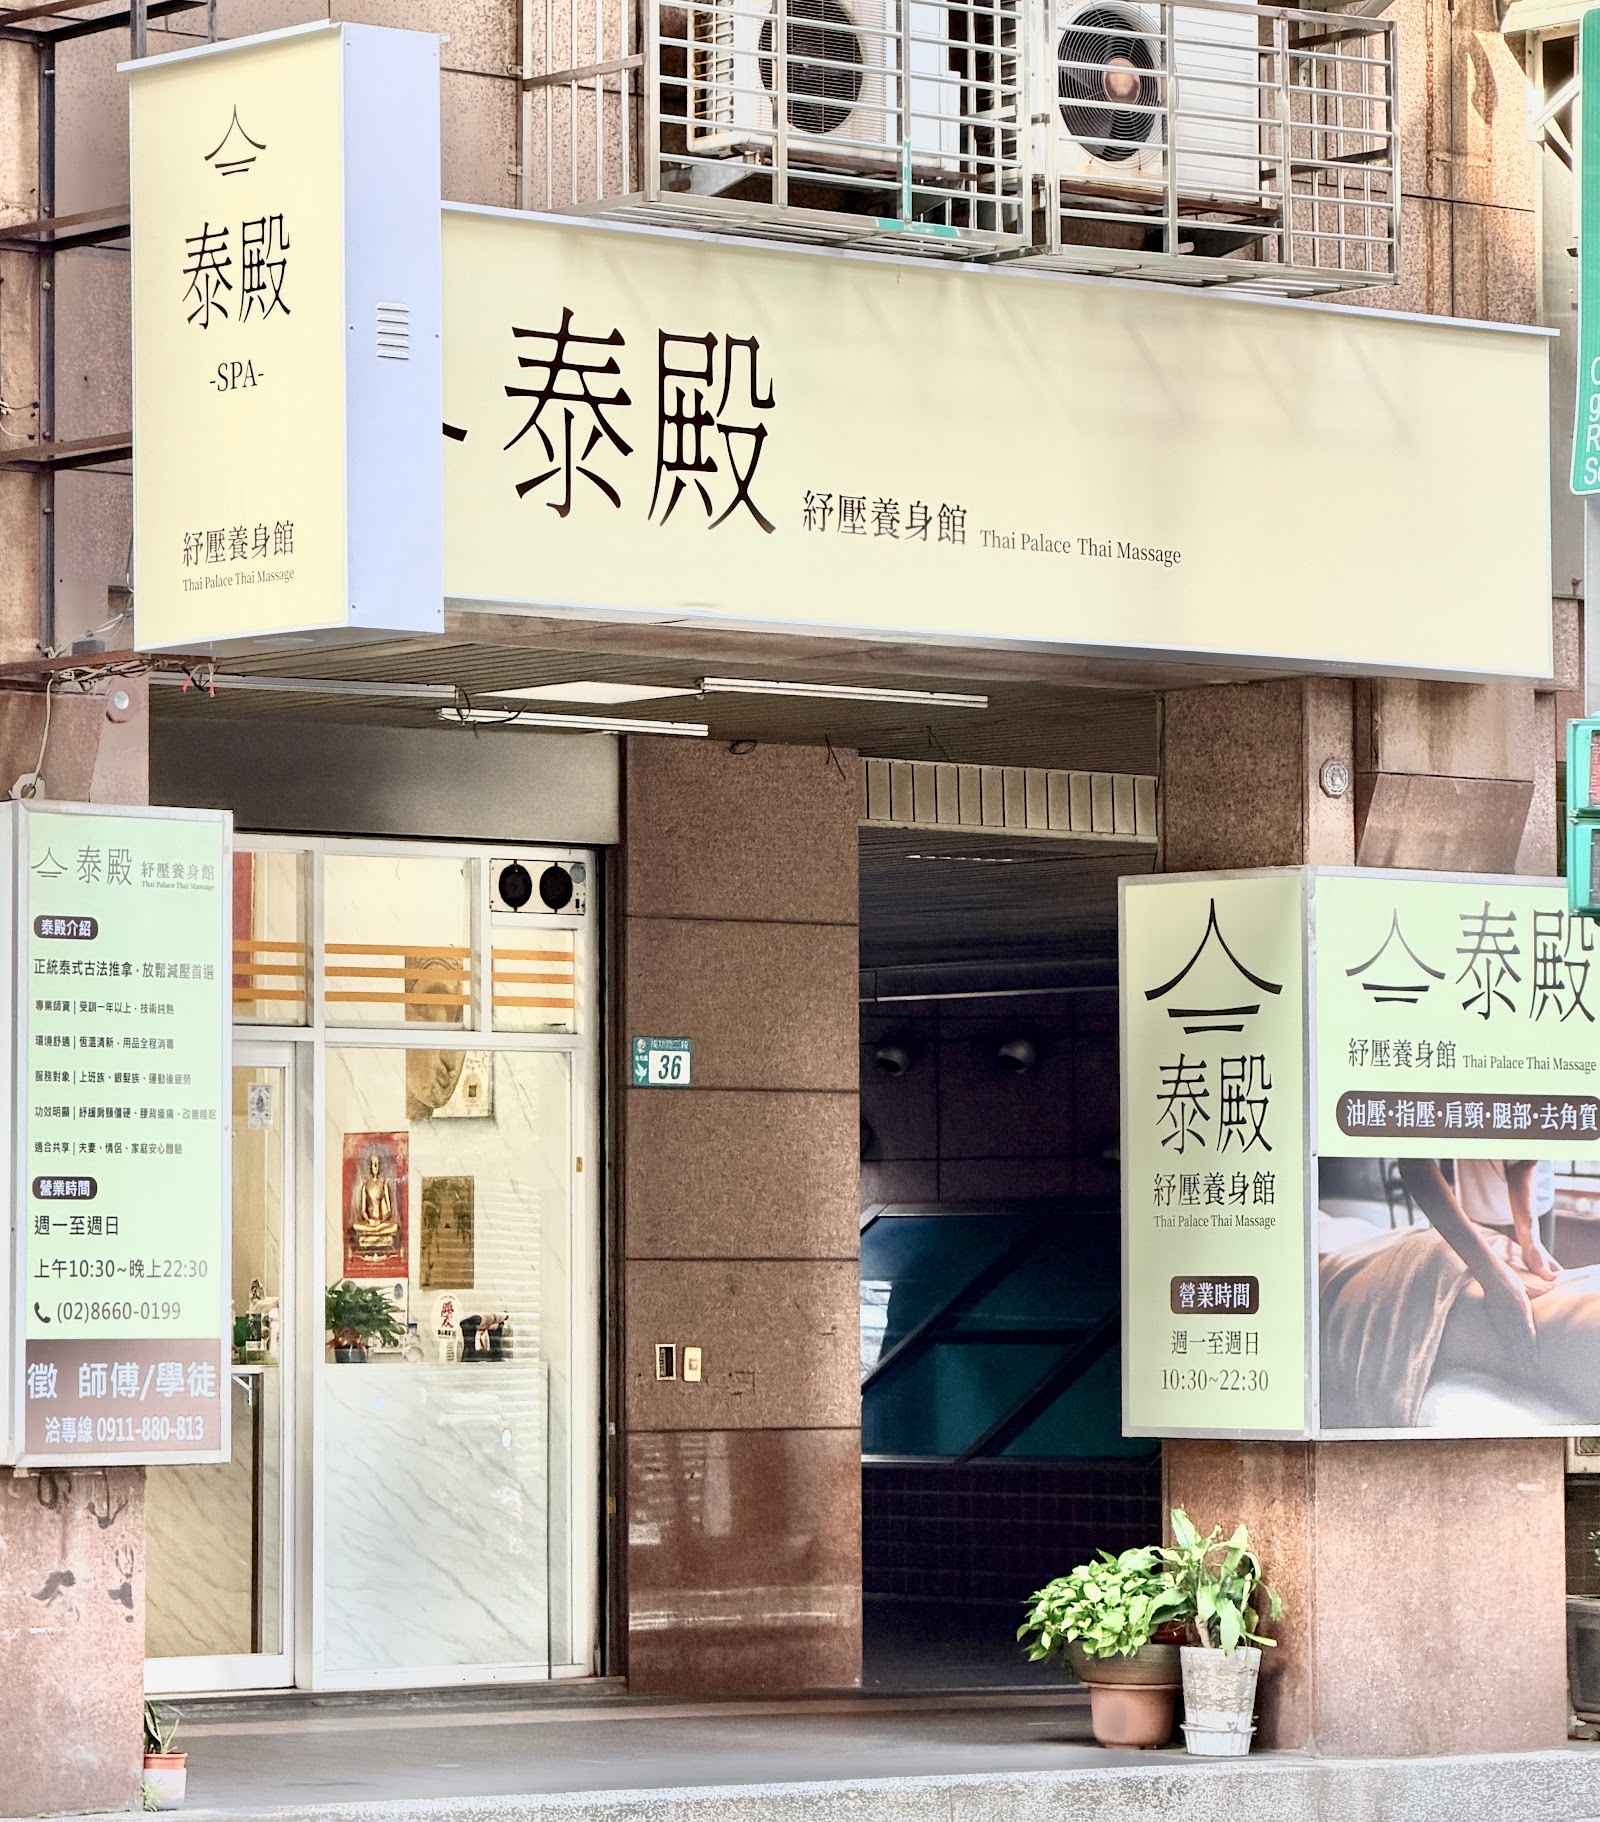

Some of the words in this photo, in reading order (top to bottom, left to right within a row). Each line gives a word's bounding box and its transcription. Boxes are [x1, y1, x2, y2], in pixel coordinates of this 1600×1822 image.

[183, 213, 291, 330] 泰殿
[503, 306, 776, 534] 泰殿
[802, 489, 967, 546] 紓壓養身館
[183, 520, 294, 566] 紓壓養身館
[980, 530, 1016, 550] Thai
[1021, 533, 1071, 554] Palace
[1077, 538, 1112, 558] Thai
[1116, 542, 1182, 568] Massage
[183, 577, 202, 591] Thai
[205, 575, 233, 589] Palace
[235, 571, 255, 585] Thai
[258, 570, 294, 583] Massage
[76, 845, 132, 885] 泰殿
[141, 862, 215, 880] 紓壓養身館
[191, 884, 215, 892] Massage
[41, 919, 91, 937] 泰殿介紹
[1456, 900, 1596, 1022] 泰殿
[1349, 1038, 1456, 1069] 紓壓養身館
[1463, 1055, 1487, 1068] Thai
[1490, 1056, 1524, 1069] Palace
[1526, 1057, 1550, 1069] Thai
[1553, 1058, 1596, 1074] Massage
[659, 1055, 682, 1079] 36
[1156, 1053, 1272, 1155] 泰殿
[40, 1179, 91, 1197] 營業時間
[1153, 1171, 1275, 1206] 紓壓養身館
[34, 1215, 119, 1236] 週一至週日
[1154, 1215, 1175, 1228] Thai
[1178, 1215, 1208, 1227] Palace
[1211, 1215, 1232, 1227] Thai
[1235, 1214, 1276, 1229] Massage
[34, 1259, 208, 1279] 上午10:30~晚上22:30
[1179, 1282, 1250, 1308] 營業時間
[57, 1302, 181, 1323] (02)8660-0199
[1171, 1330, 1259, 1355] 週一至週日
[27, 1362, 58, 1399] 徵
[78, 1361, 217, 1401] 師傅/學徒
[1161, 1369, 1269, 1391] 10:30~22:30
[45, 1416, 93, 1443] 洽專線
[96, 1415, 204, 1441] 0911-880-813
